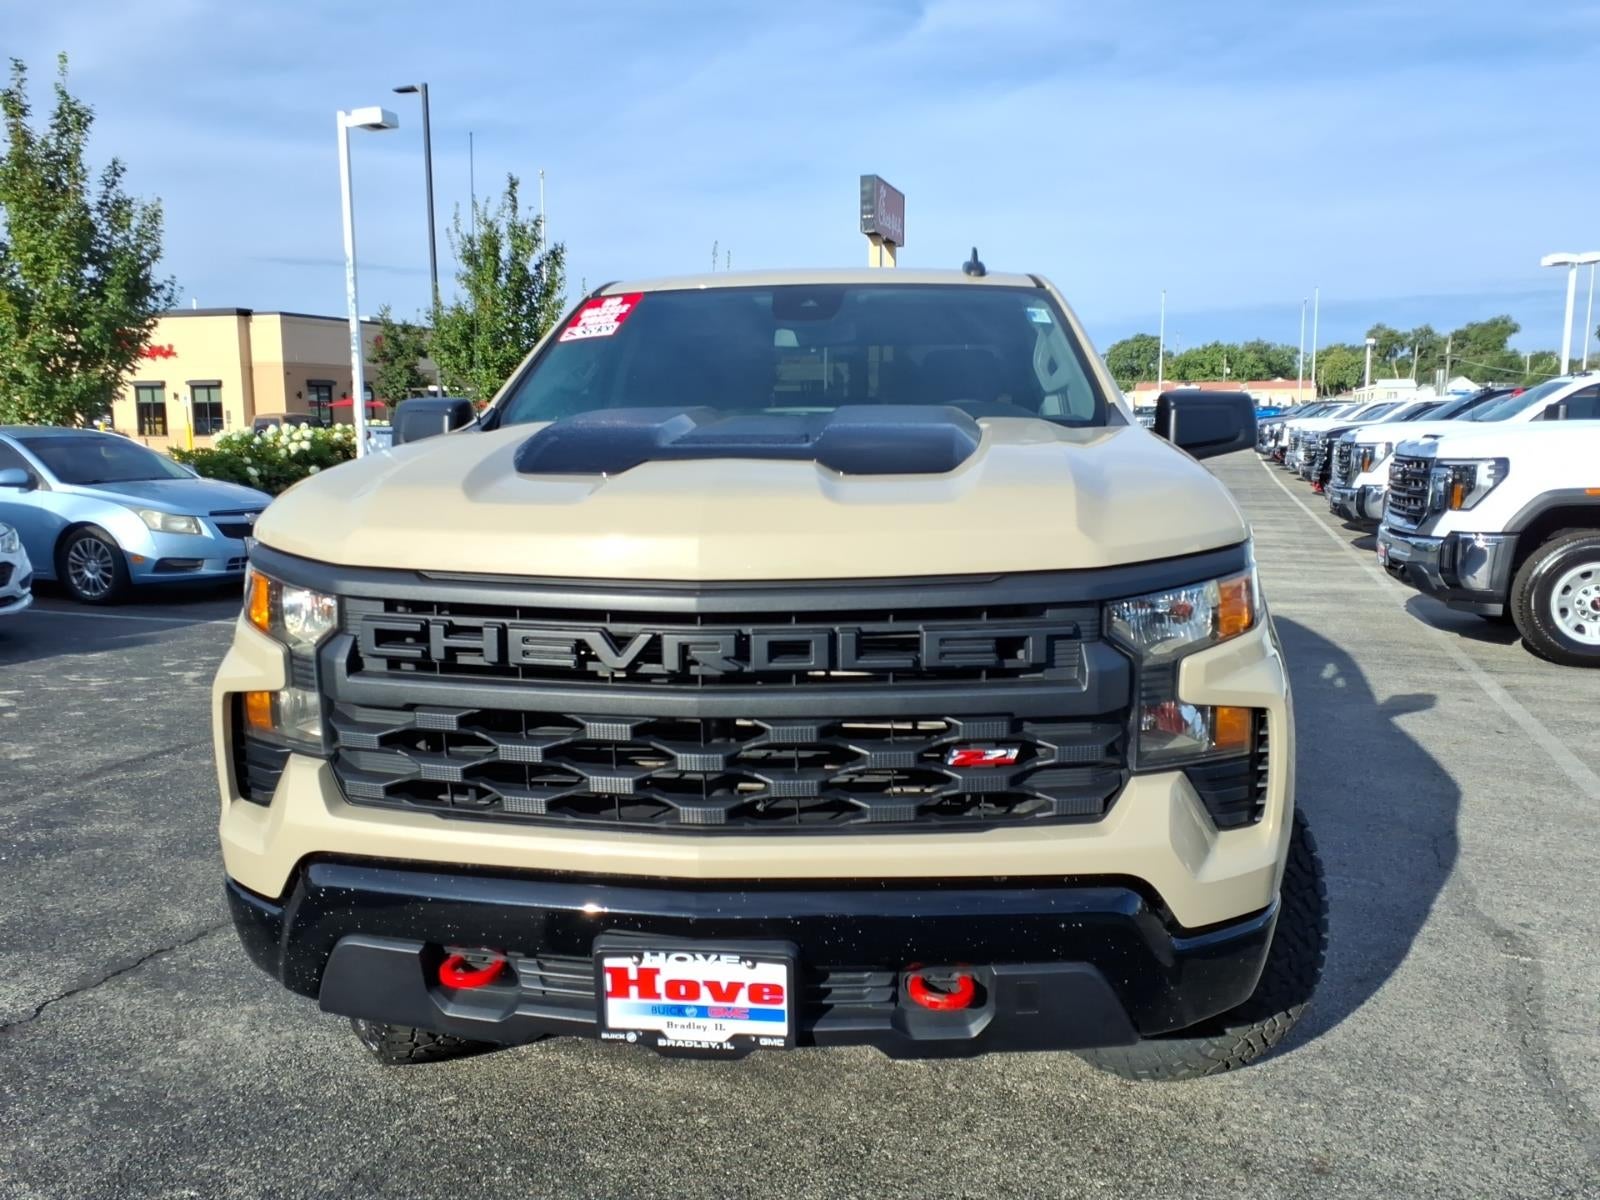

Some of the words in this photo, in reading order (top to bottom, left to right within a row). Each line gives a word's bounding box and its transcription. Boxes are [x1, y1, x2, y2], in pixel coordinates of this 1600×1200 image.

[361, 615, 1081, 674] CHEVROLET
[605, 966, 784, 1005] Hove
[651, 1005, 684, 1016] BUICK
[708, 1007, 750, 1019] GMC
[601, 1032, 625, 1040] BUICK
[760, 1038, 785, 1047] GMC
[723, 1041, 735, 1050] IL
